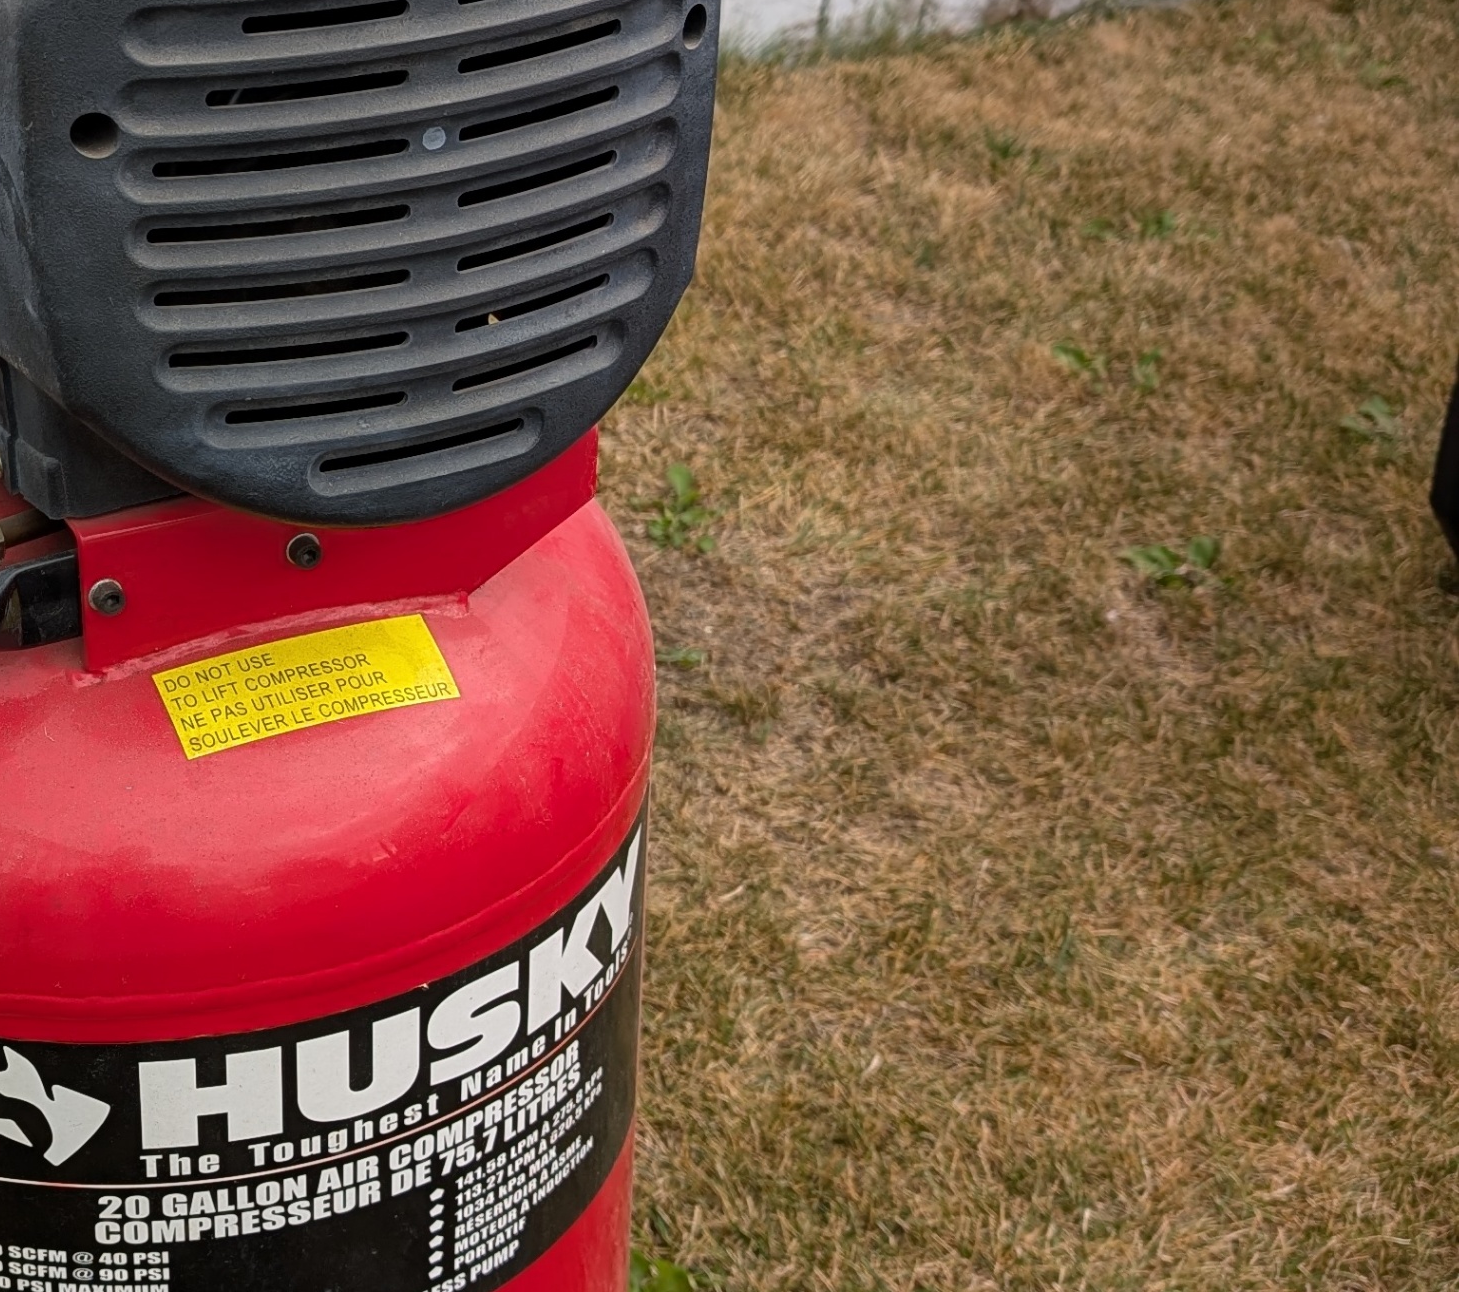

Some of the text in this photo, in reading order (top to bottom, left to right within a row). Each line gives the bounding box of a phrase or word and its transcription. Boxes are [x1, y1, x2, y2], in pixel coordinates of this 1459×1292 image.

[163, 653, 275, 693] DO NOT USE
[171, 653, 371, 712] TO LIFT COMPRESSOR
[179, 671, 388, 732] NE PAS UTILISER POUR
[189, 682, 452, 752] SOULEVER LE COMPRESSEUR
[138, 823, 641, 1149] HUSKY
[140, 1154, 220, 1178] The
[248, 1093, 439, 1167] Toughest
[460, 1034, 546, 1102] Name
[555, 1007, 576, 1041] In
[94, 1177, 381, 1245] COMPRESSEUR
[391, 1165, 431, 1197] DE
[504, 1062, 581, 1142] LITRES
[98, 1039, 579, 1219] 20 GALLON AIR COMPRESSOR
[455, 1152, 507, 1190] 141.58
[510, 1129, 539, 1159] LPM
[552, 1089, 583, 1127] 275.8
[550, 1135, 582, 1174] ASME
[454, 1191, 495, 1222] 1034
[528, 1145, 557, 1177] MAX
[454, 1208, 517, 1255] MOTEUR
[532, 1135, 594, 1205] INDUCTION
[455, 1169, 504, 1206] 113.27
[507, 1148, 536, 1177] LPM
[7, 1245, 67, 1263] SCFM
[72, 1251, 94, 1265] @
[98, 1252, 125, 1265] 40
[133, 1251, 169, 1265] PSI
[8, 1261, 67, 1280] SCFM
[72, 1267, 94, 1281] @
[99, 1268, 125, 1282] 90
[134, 1267, 170, 1281] PSI
[453, 1216, 527, 1271] PORTATIF
[470, 1239, 520, 1282] PUMP
